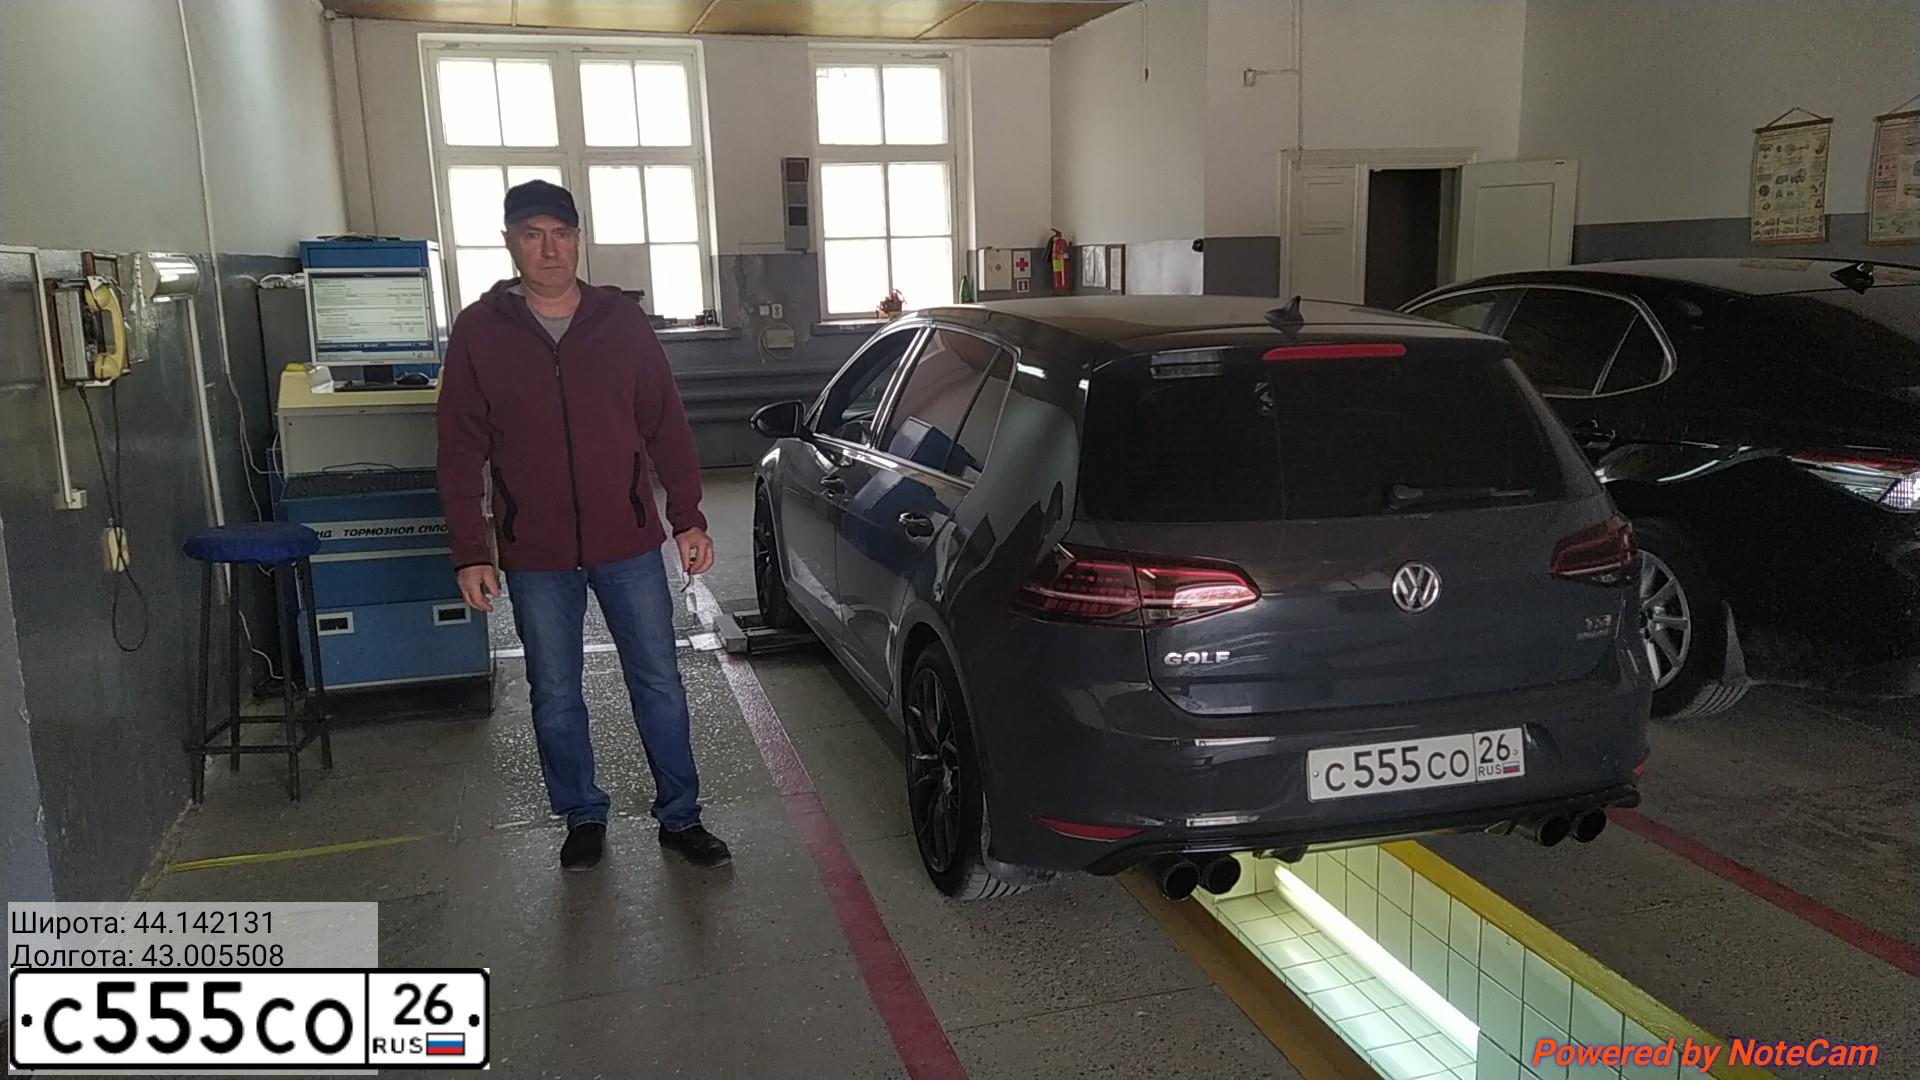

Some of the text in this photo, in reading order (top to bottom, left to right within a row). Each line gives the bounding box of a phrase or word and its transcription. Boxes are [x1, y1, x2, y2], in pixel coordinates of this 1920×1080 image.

[1163, 651, 1232, 666] GOLF
[1477, 733, 1511, 764] 26
[1477, 765, 1503, 777] RUS
